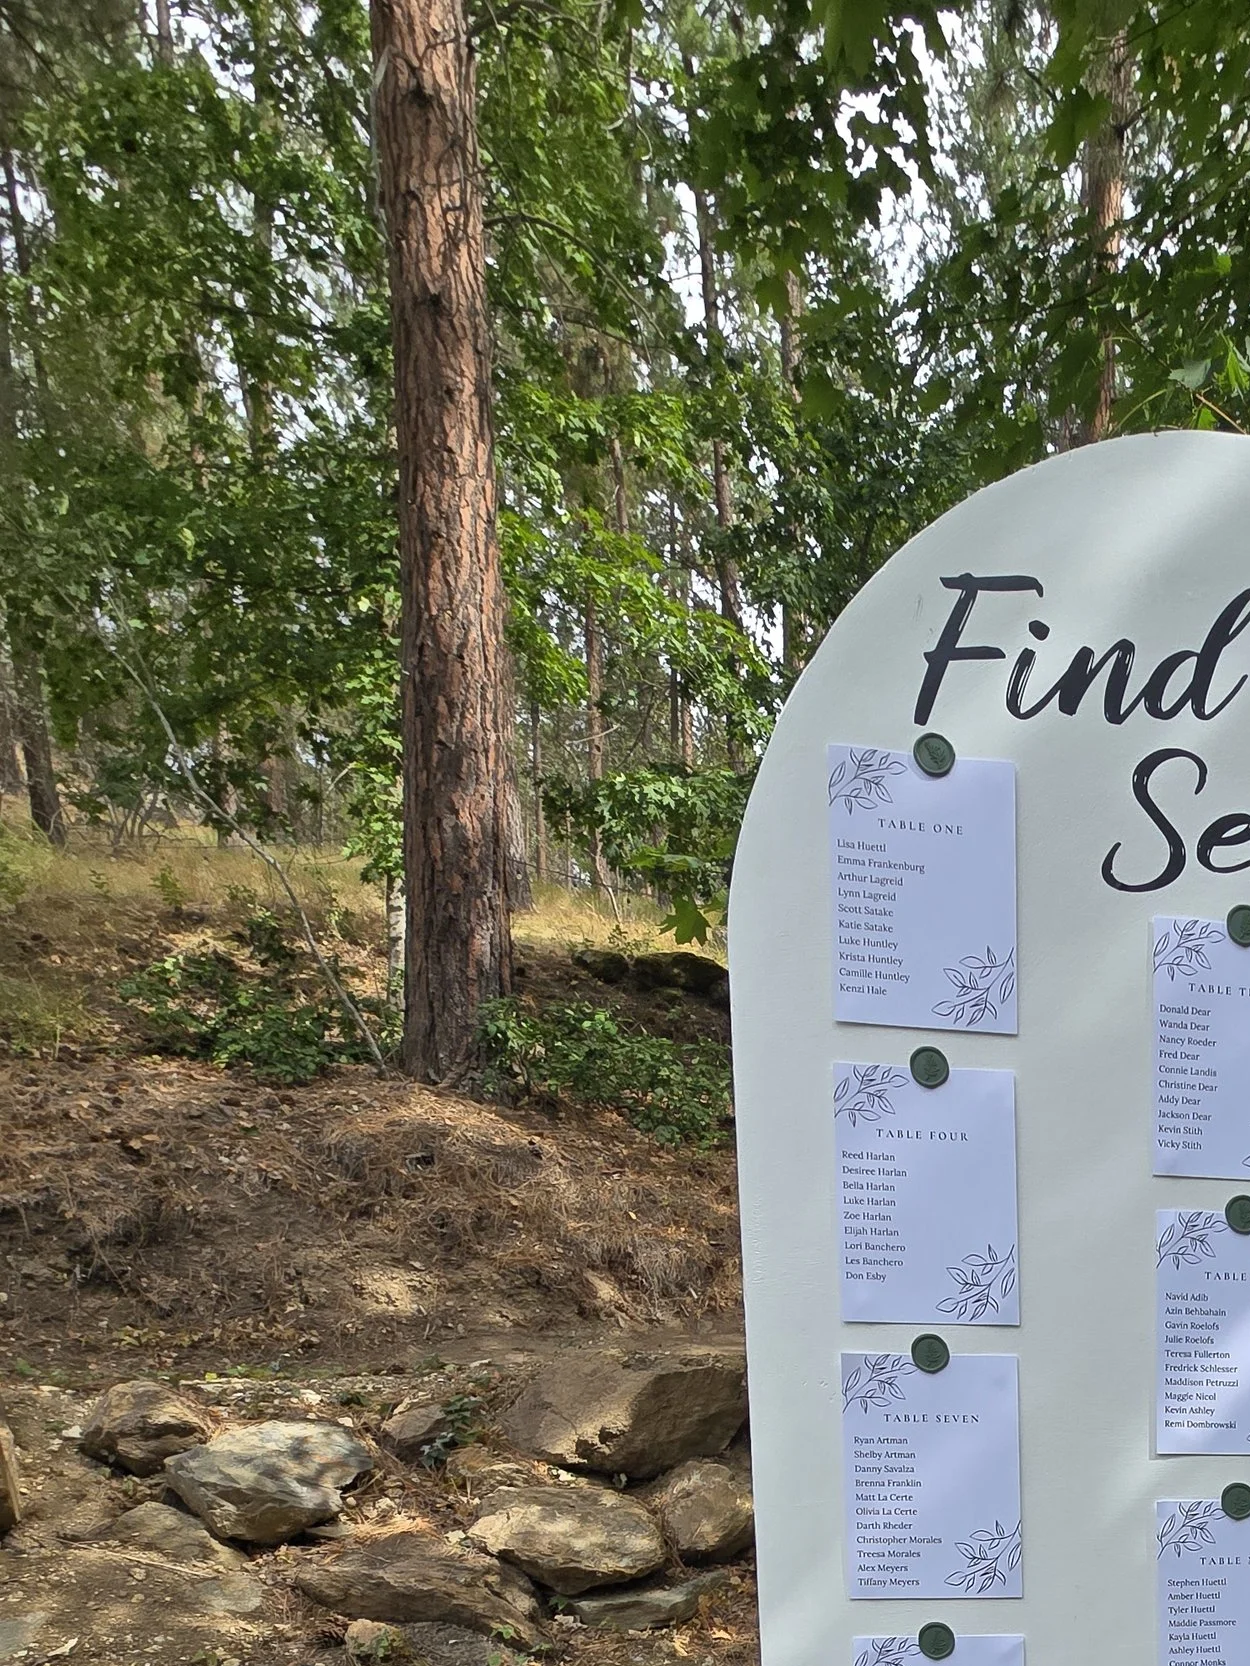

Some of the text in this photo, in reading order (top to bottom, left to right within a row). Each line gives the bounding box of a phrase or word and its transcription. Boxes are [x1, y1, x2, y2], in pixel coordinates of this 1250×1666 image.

[877, 818, 963, 835] TABLE ONE
[837, 838, 886, 853] Lisa Huettl
[837, 854, 925, 875] Emma Frankenburg
[837, 903, 894, 917] Scott Satake
[1188, 982, 1232, 996] TABLE
[1159, 1004, 1211, 1017] Donald Dear
[1159, 1034, 1217, 1049] Nancy Roeder
[875, 1128, 968, 1141] TABLE FOUR
[1158, 1124, 1203, 1136] Kevin Stith
[842, 1150, 896, 1162] Reed Harlan
[844, 1241, 906, 1252] Lori Banchero
[845, 1271, 887, 1283] Don Esby
[1204, 1271, 1247, 1281] TABLE
[1164, 1320, 1220, 1331] Gavin Roelofs
[1164, 1405, 1215, 1417] Kevin Ashley
[883, 1413, 979, 1424] TABLE SEVEN
[1164, 1419, 1236, 1429] Remi Dombrowski
[854, 1436, 908, 1447] Ryan Artman
[855, 1493, 914, 1502] Matt La Certe
[856, 1521, 881, 1530] Darth
[1199, 1556, 1241, 1566] TABLE
